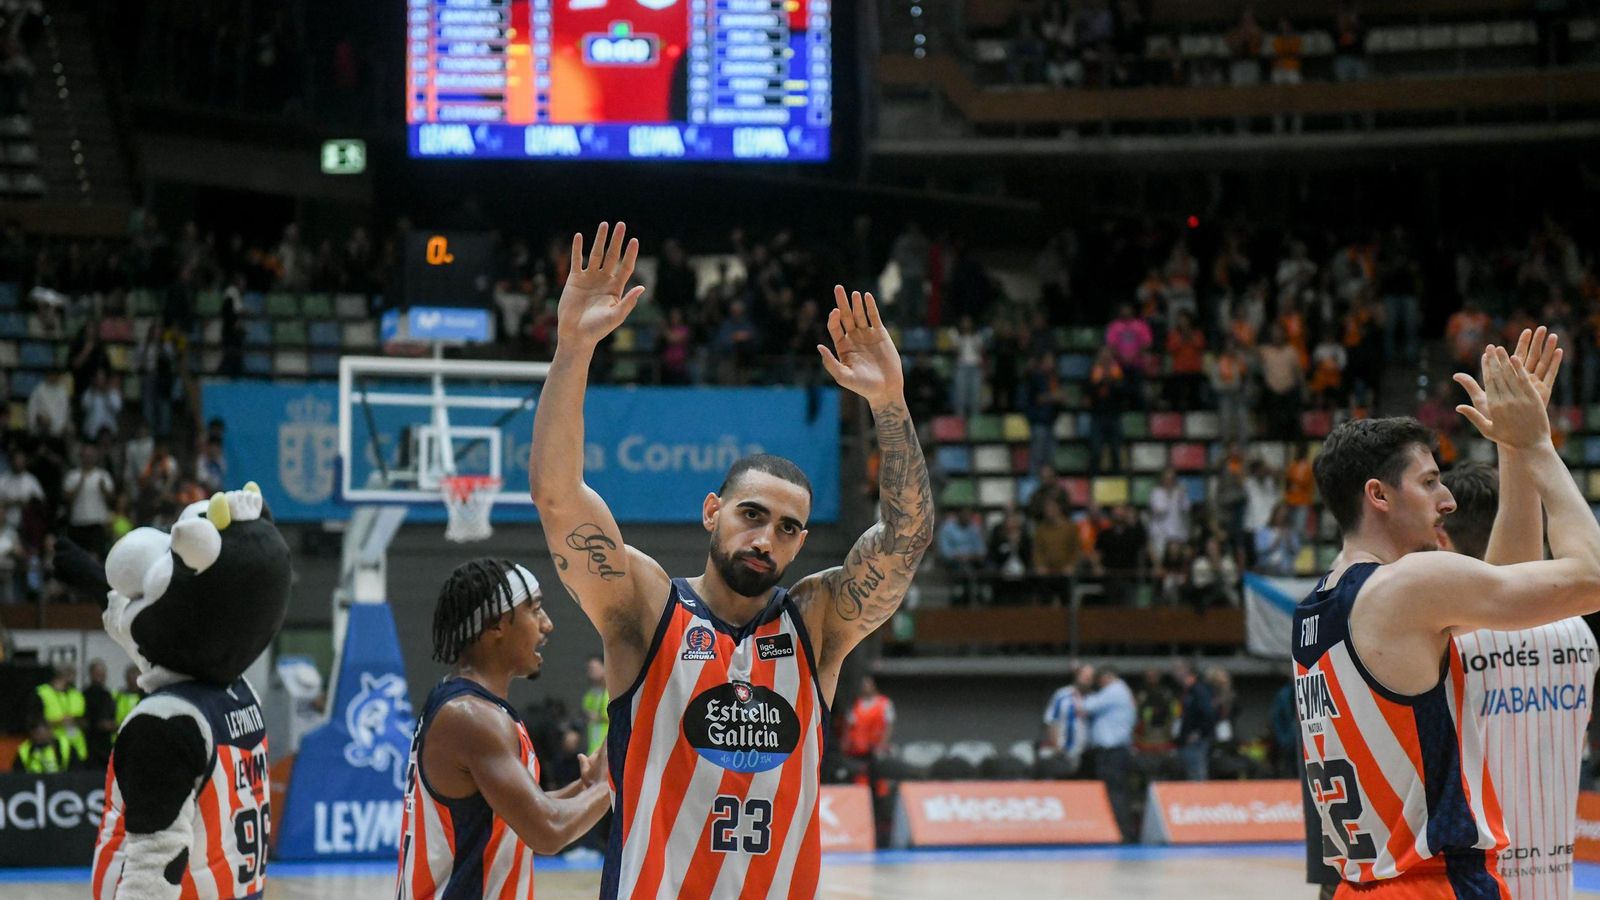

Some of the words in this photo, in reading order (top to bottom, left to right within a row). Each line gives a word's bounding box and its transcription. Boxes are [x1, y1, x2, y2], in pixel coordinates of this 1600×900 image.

[836, 560, 886, 621] First
[761, 648, 793, 658] endesa
[704, 699, 782, 725] Estrella
[707, 722, 780, 748] Galicia
[314, 801, 405, 854] LEYM
[711, 794, 774, 855] 23
